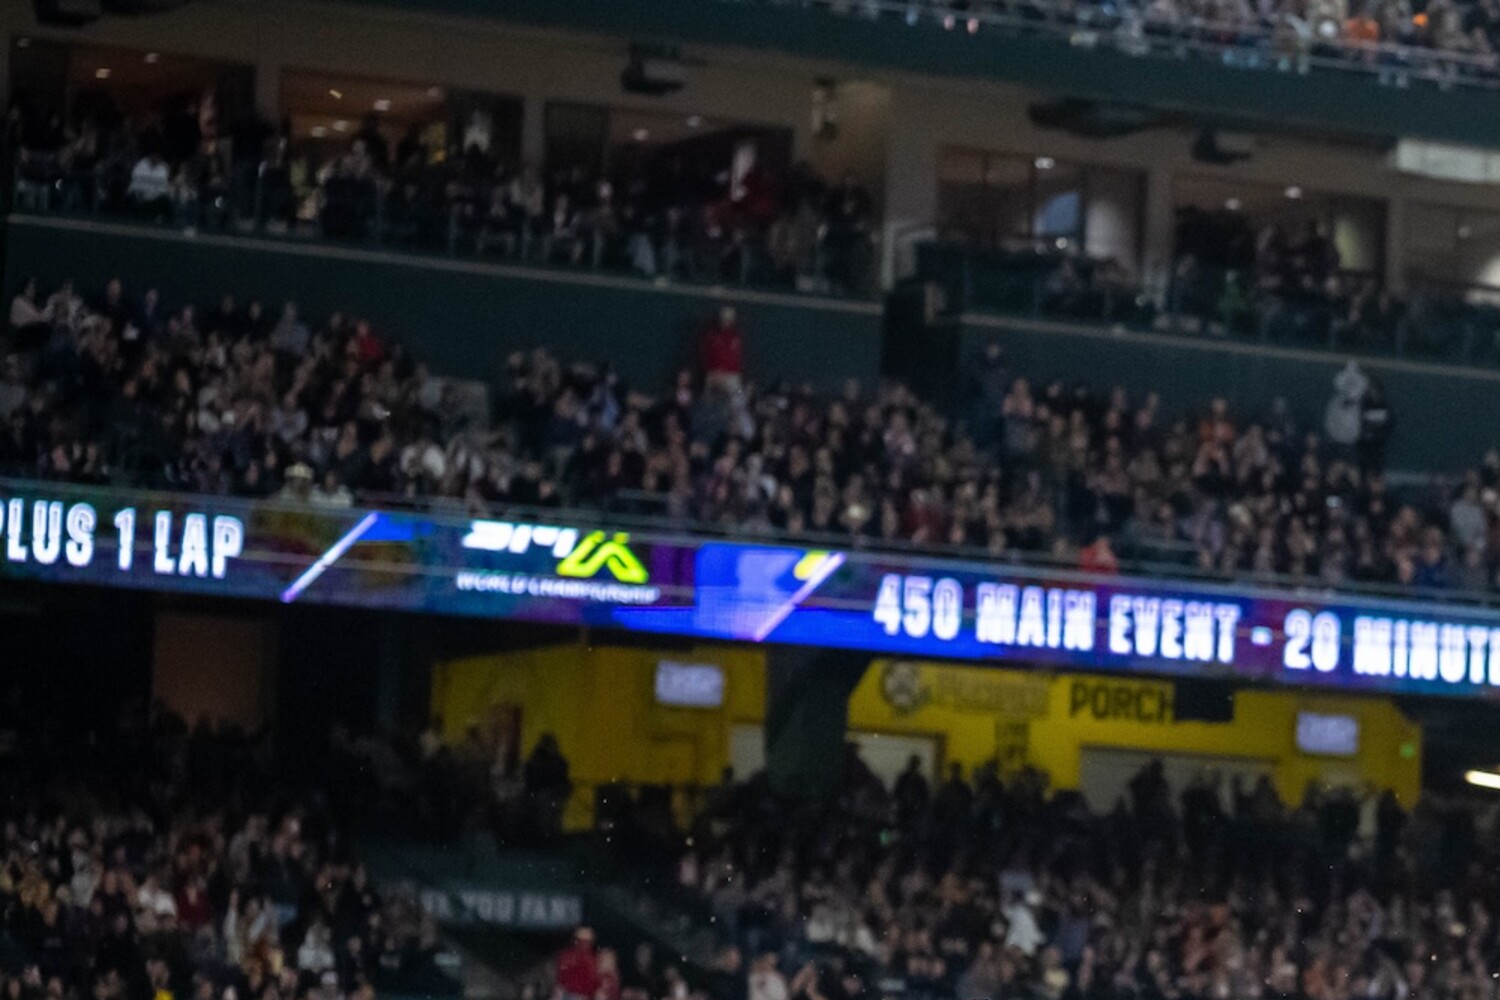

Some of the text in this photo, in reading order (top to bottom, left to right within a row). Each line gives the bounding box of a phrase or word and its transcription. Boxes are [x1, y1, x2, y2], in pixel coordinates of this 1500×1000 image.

[0, 497, 245, 580] LUS 1 LAP
[872, 573, 965, 641] 450
[975, 581, 1097, 652] MAIN
[1109, 594, 1242, 664] EVENT
[1282, 608, 1342, 673] 20
